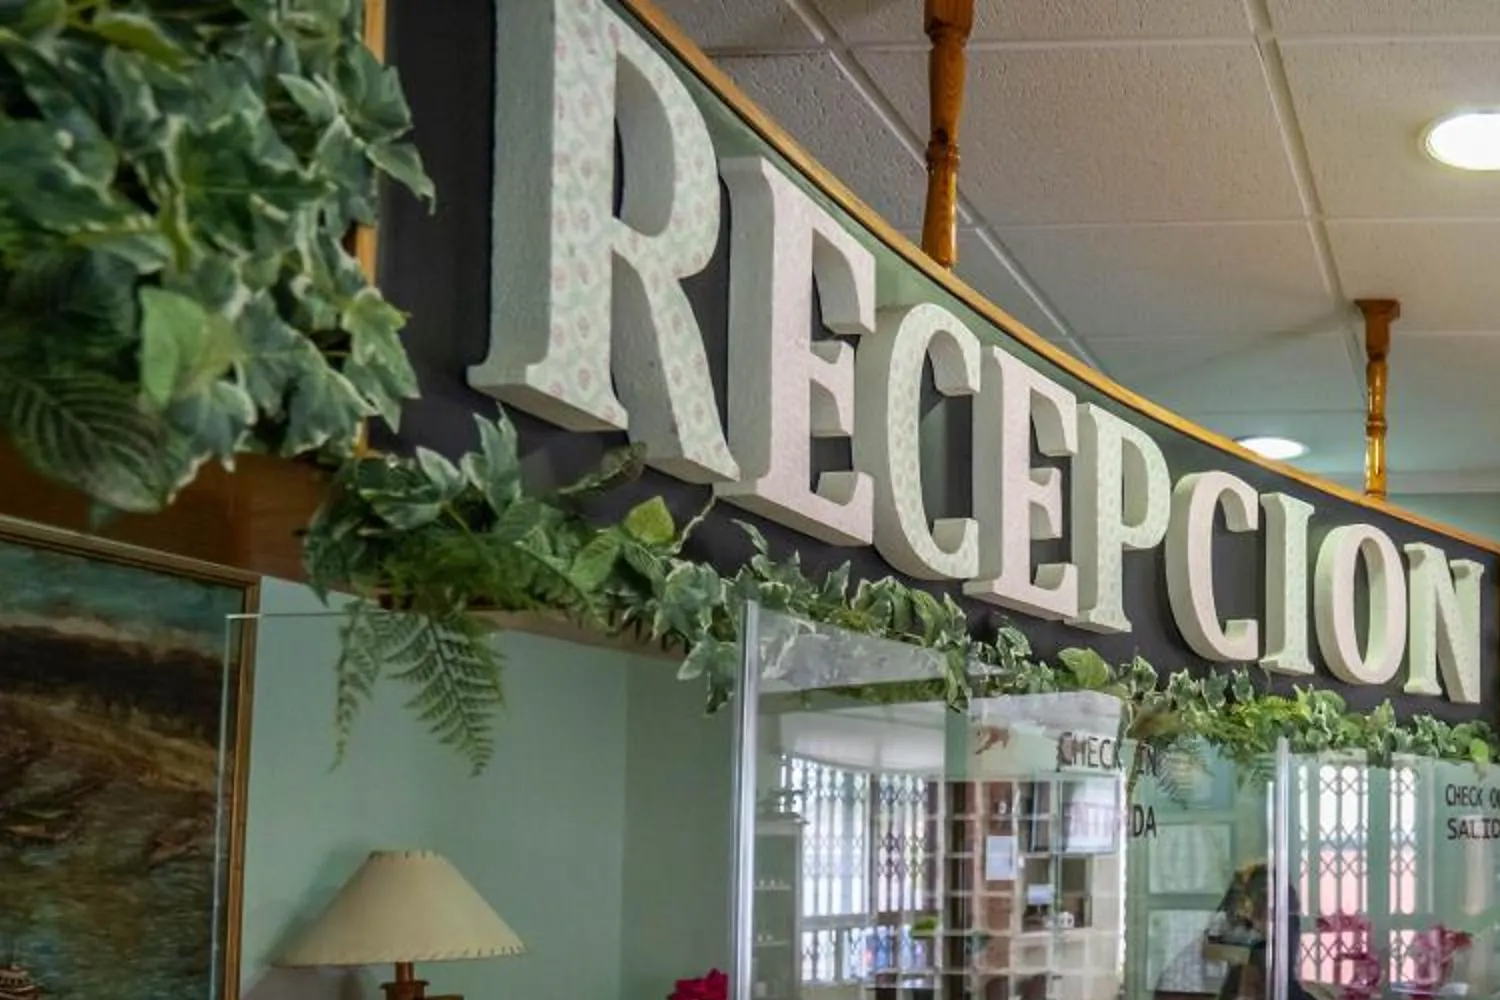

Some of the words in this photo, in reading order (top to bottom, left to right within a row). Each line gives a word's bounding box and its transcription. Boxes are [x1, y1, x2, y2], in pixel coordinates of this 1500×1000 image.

[467, 0, 1484, 703] RECEPCION
[1057, 731, 1122, 772] CHECK
[1445, 783, 1483, 807] CHECK
